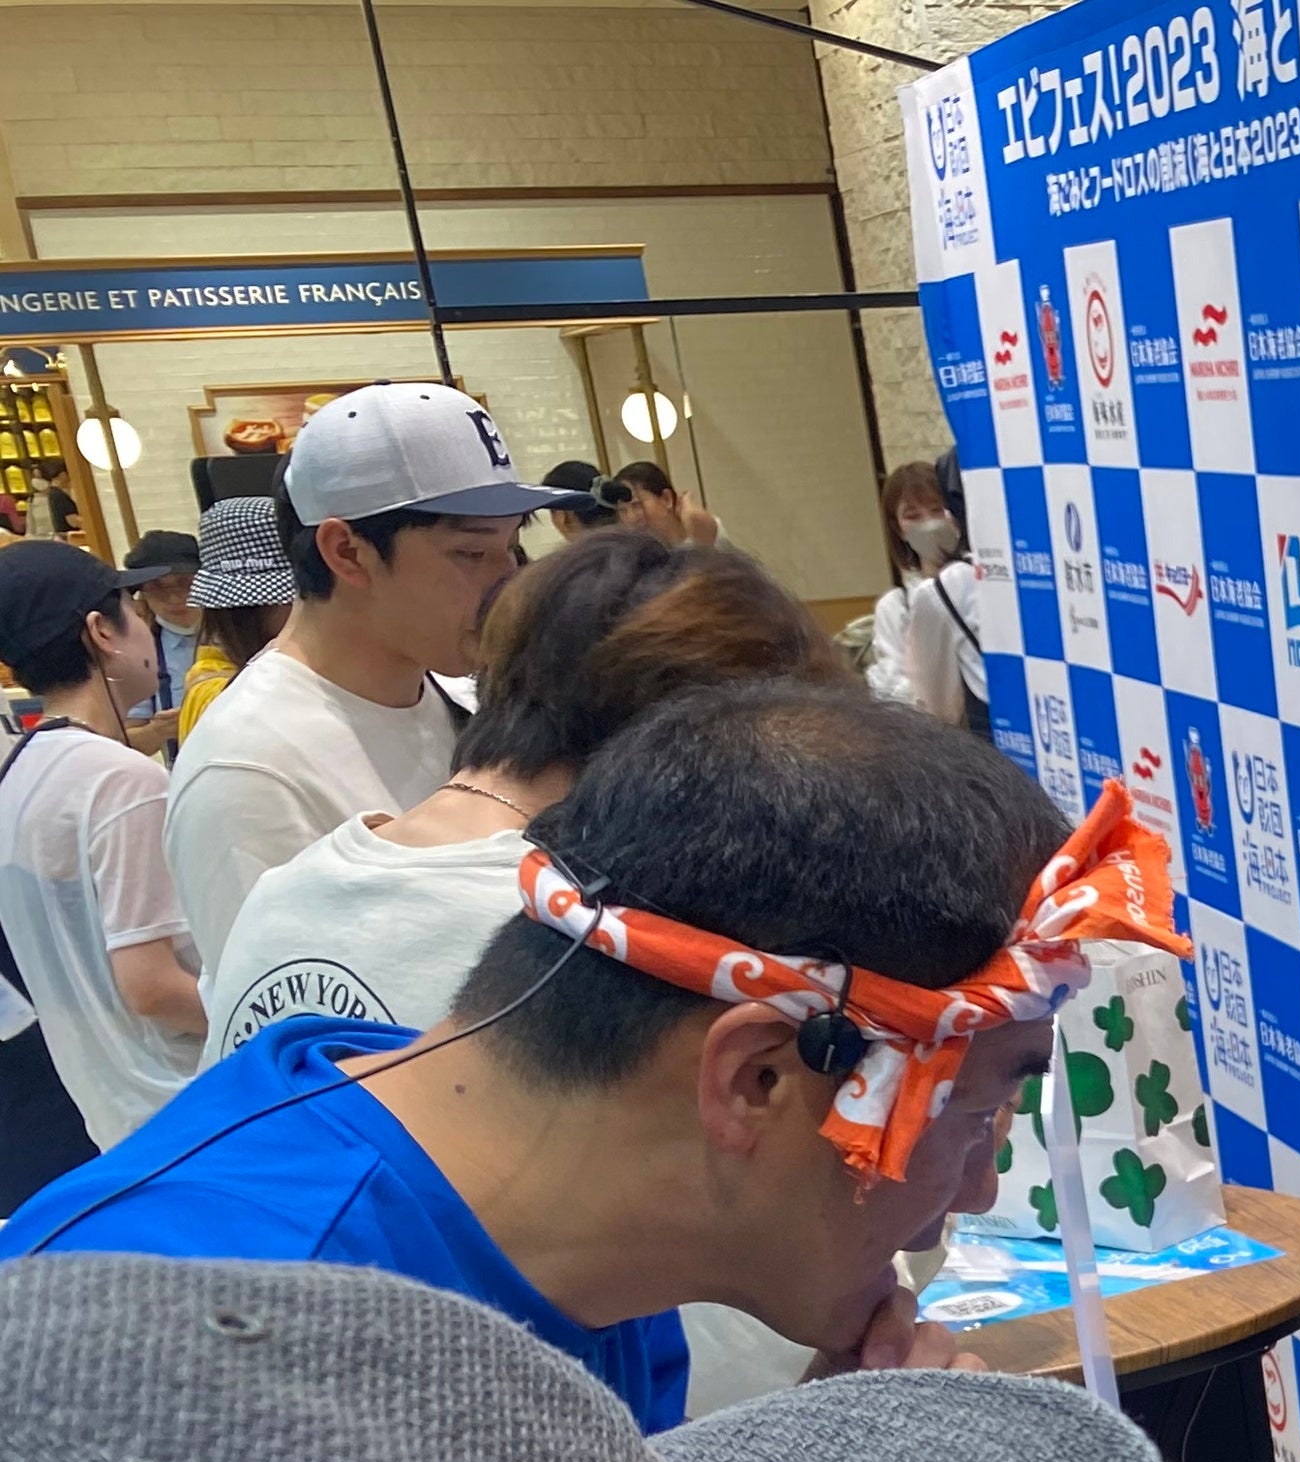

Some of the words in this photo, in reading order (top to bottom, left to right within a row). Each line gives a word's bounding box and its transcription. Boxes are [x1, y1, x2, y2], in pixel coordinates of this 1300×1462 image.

[0, 289, 100, 313] NGERIE
[109, 289, 139, 310] ET
[148, 284, 290, 308] PATISSERIE
[298, 280, 423, 307] FRANÇAIS
[466, 409, 511, 469] E
[1252, 754, 1279, 794] 日本
[249, 972, 312, 1029] NEW
[316, 974, 380, 1024] YOR
